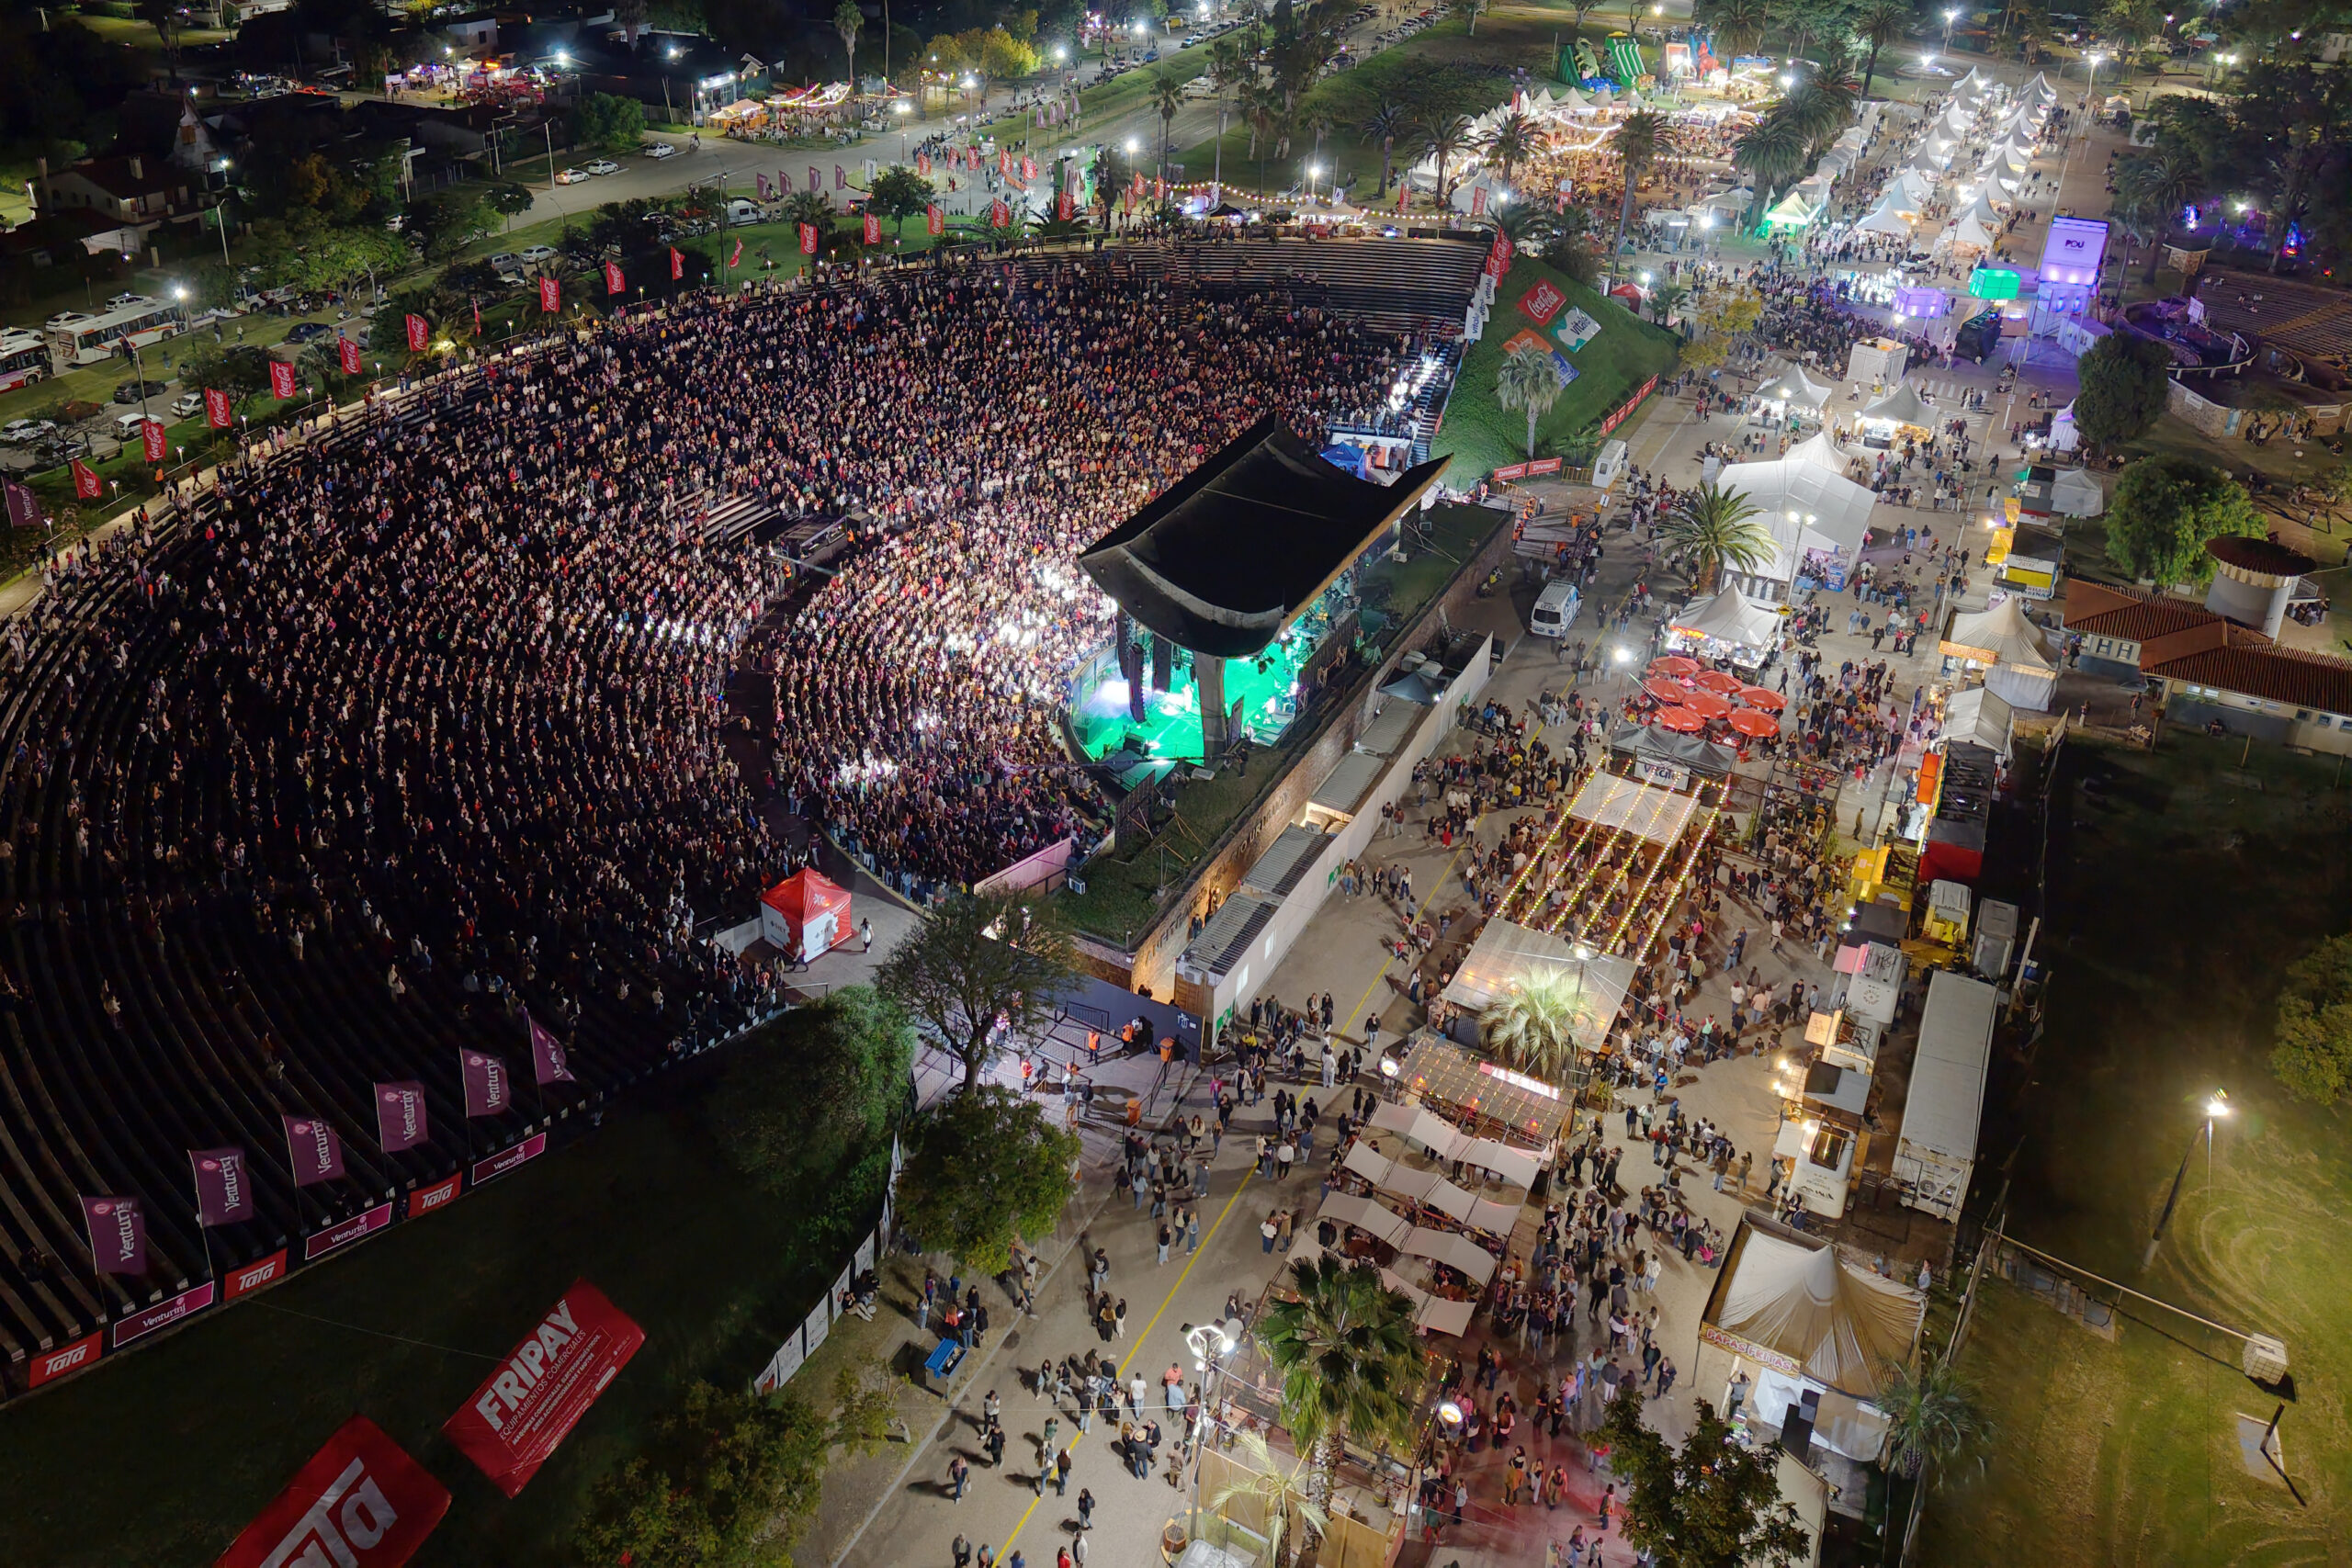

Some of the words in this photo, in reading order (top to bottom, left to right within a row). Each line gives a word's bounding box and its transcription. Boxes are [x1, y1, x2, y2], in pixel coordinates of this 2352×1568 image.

[142, 1304, 186, 1328] Venturini
[1707, 1329, 1747, 1352] PAPAS
[1747, 1345, 1792, 1371] FRITAS
[476, 1299, 579, 1432] FRIPAY
[499, 1379, 549, 1439] EQUIPAMIENTOS
[548, 1329, 586, 1380] COMERCIALES
